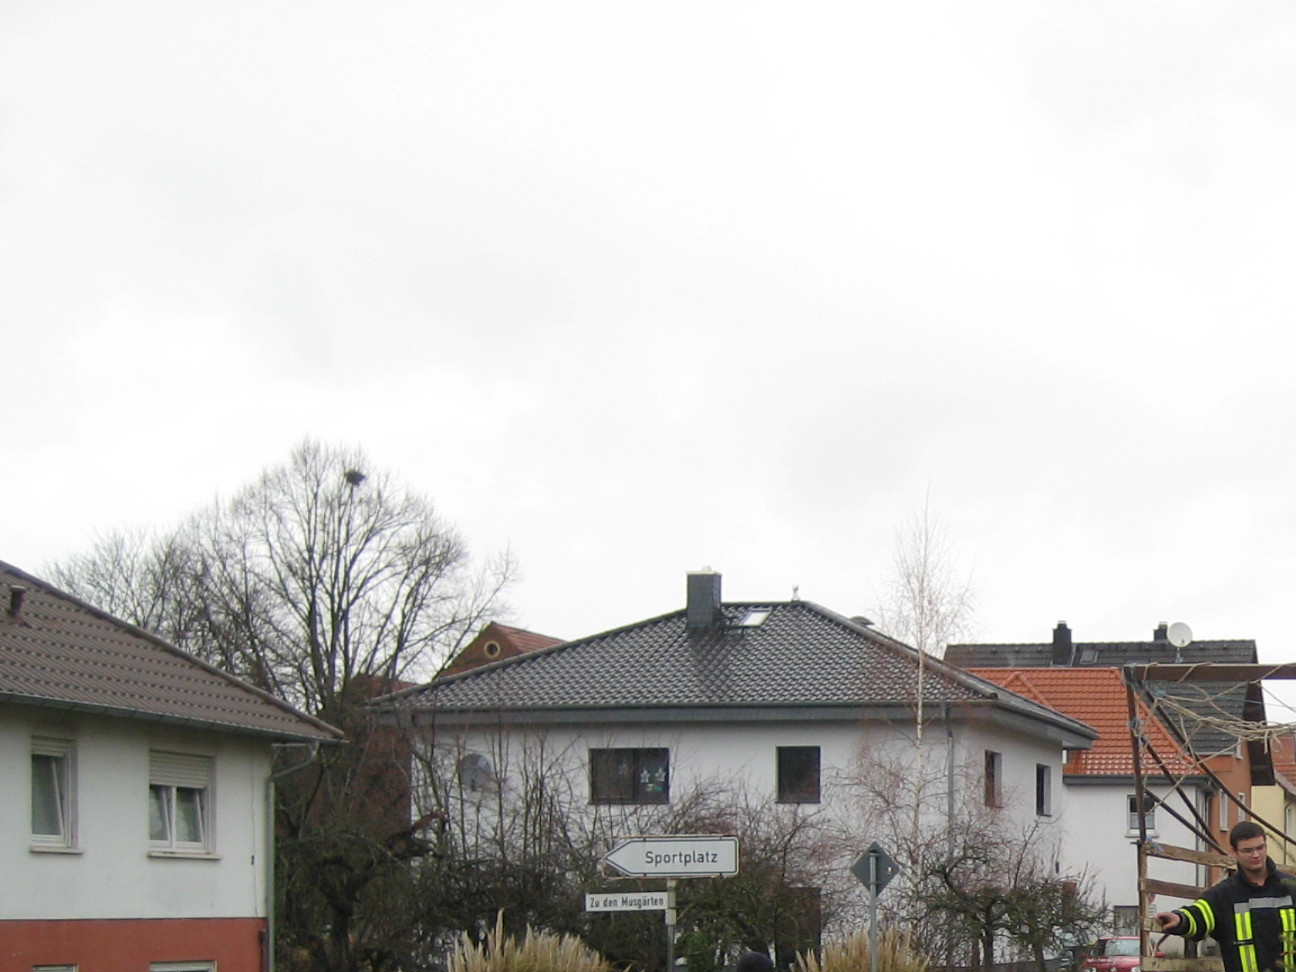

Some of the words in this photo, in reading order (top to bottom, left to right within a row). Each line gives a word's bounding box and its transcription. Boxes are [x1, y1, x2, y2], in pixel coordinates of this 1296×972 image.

[645, 850, 719, 868] Sportplatz
[590, 897, 600, 908] Zu
[603, 897, 618, 908] den
